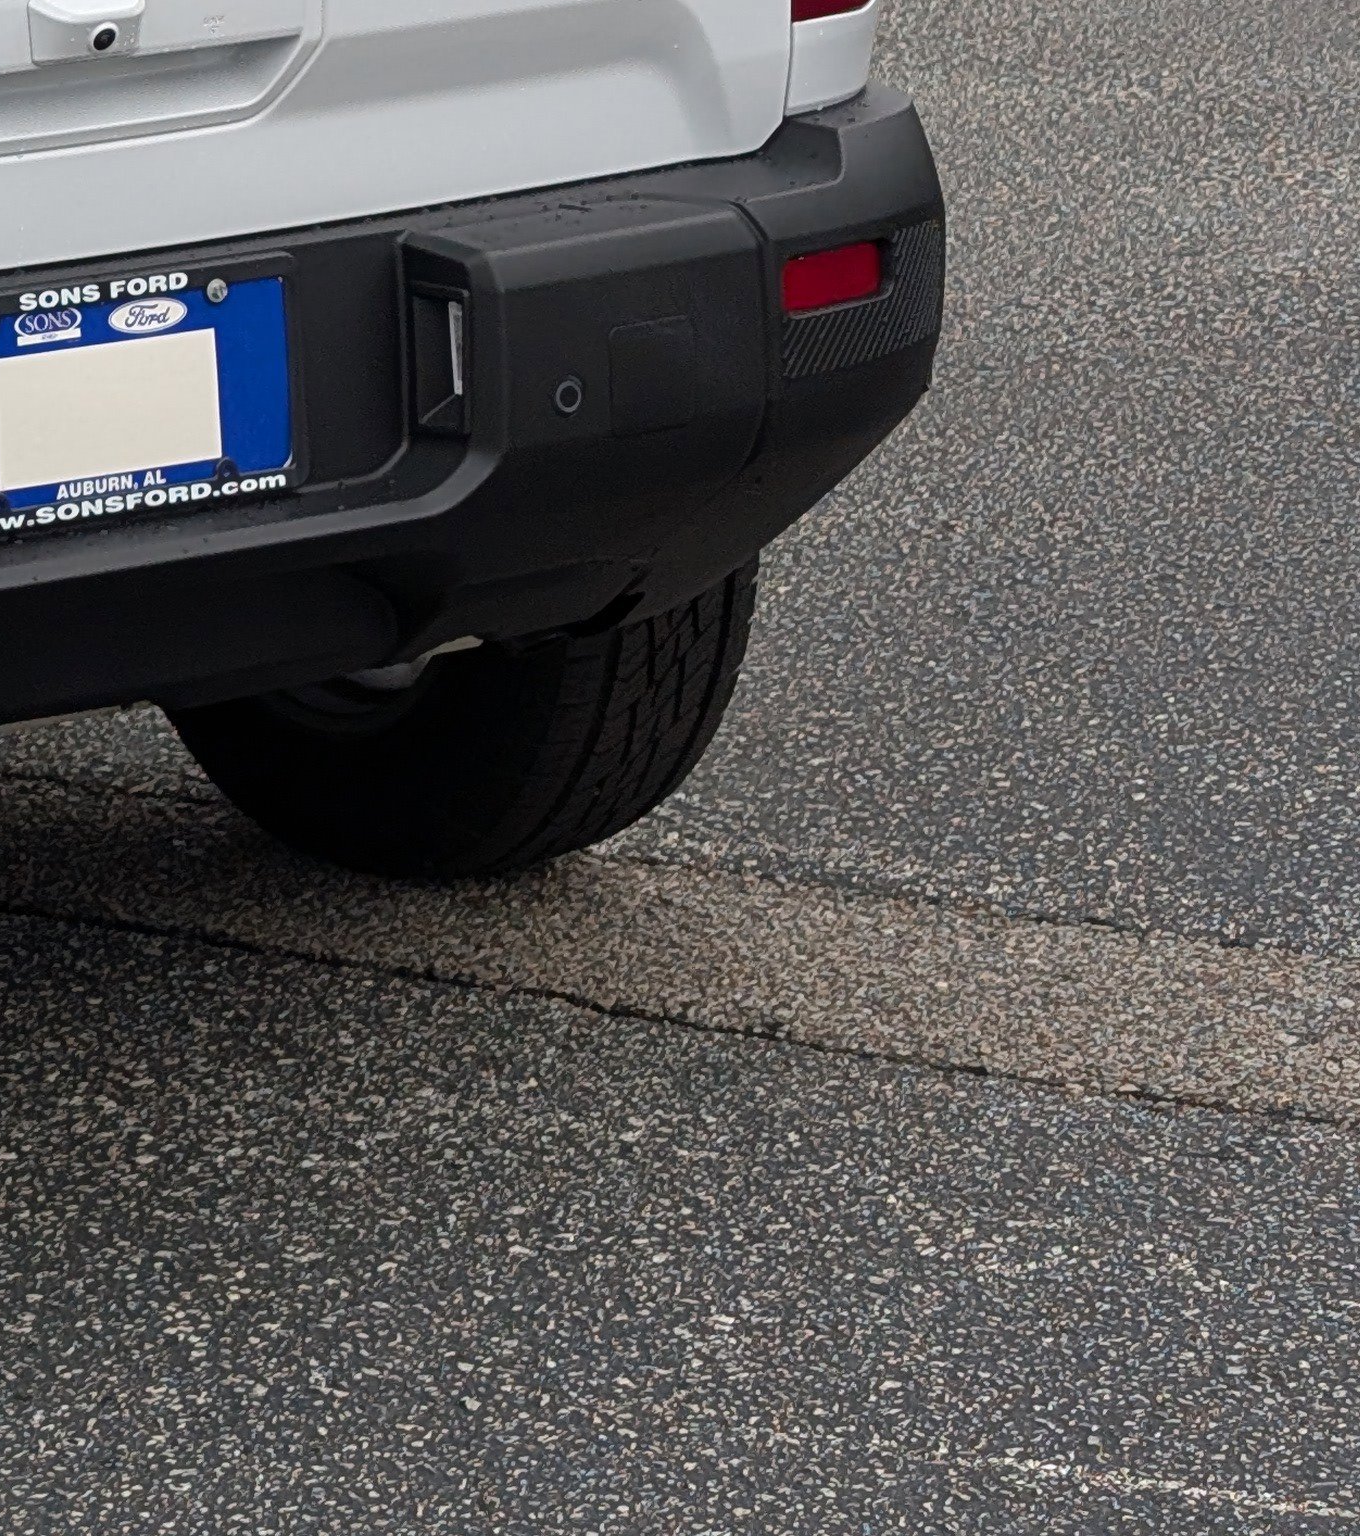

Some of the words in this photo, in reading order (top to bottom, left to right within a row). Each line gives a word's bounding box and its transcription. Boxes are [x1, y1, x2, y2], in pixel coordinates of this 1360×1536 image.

[19, 284, 101, 311] SONS
[109, 272, 189, 299] FORD
[24, 309, 72, 334] SONS
[124, 303, 171, 328] Ford
[56, 474, 139, 501] AUBURN,
[143, 468, 167, 486] AL
